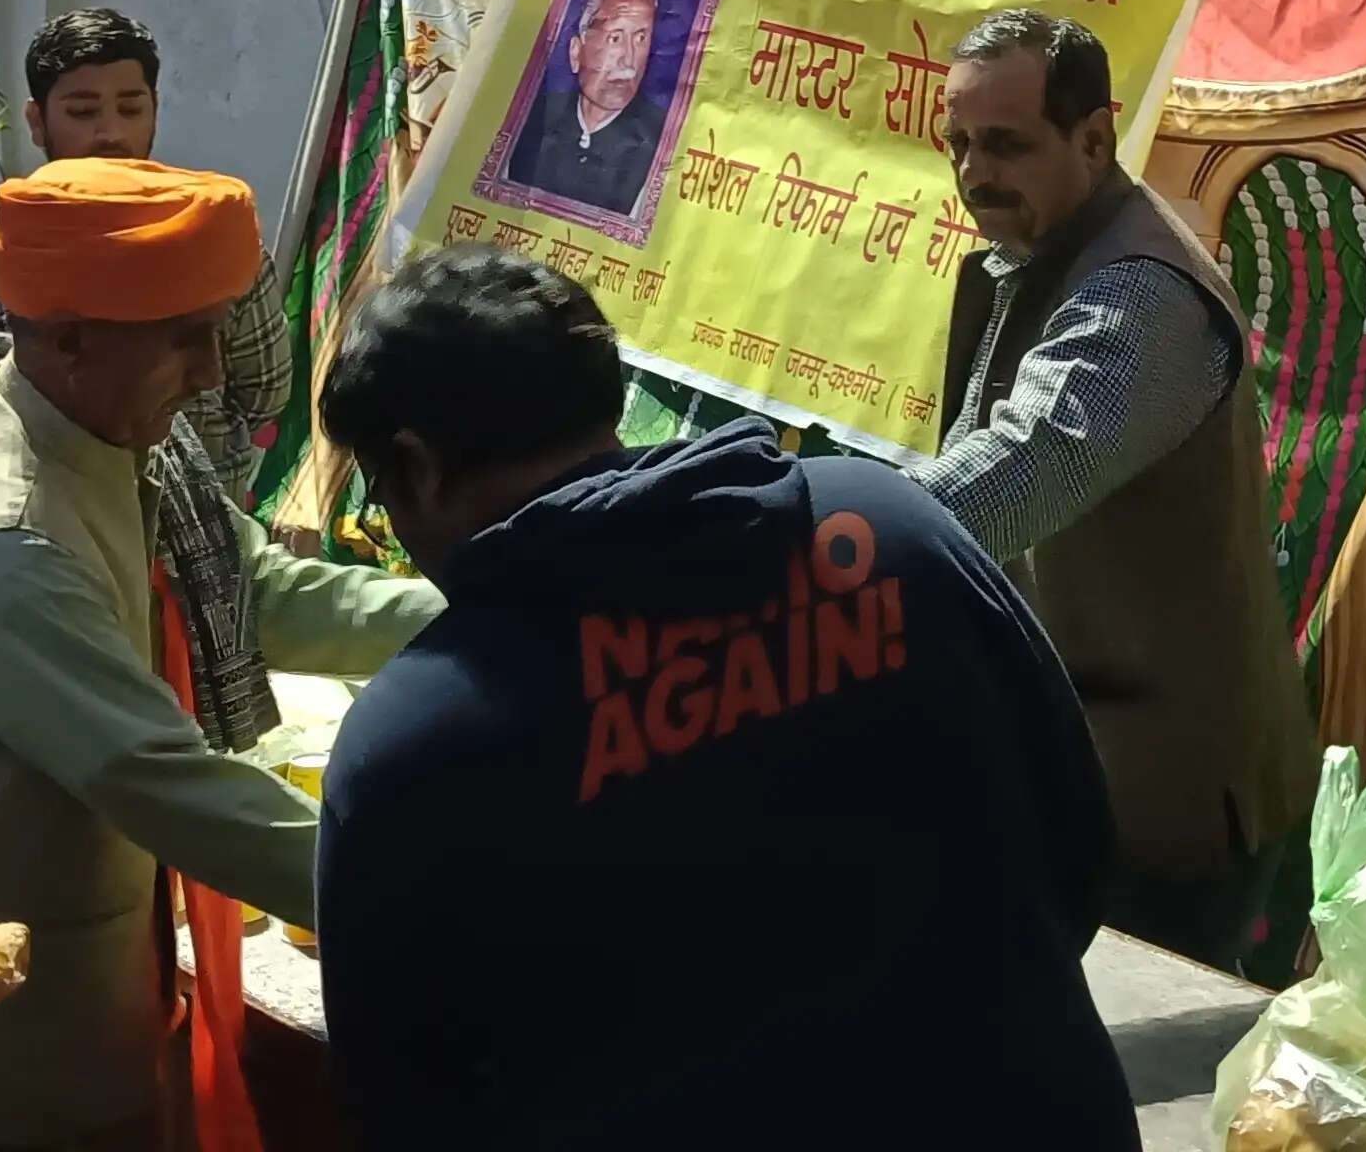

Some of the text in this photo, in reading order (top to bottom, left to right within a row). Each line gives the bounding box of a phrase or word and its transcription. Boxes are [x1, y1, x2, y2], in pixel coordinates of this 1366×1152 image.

[749, 20, 864, 119] मास्टर
[679, 129, 760, 215] सोशल
[762, 151, 868, 245] रिफार्म
[863, 188, 922, 263] एवं
[595, 256, 630, 294] लाल
[633, 260, 671, 307] शर्मा
[729, 328, 780, 369] सरताज
[578, 576, 908, 803] AGAIN!
